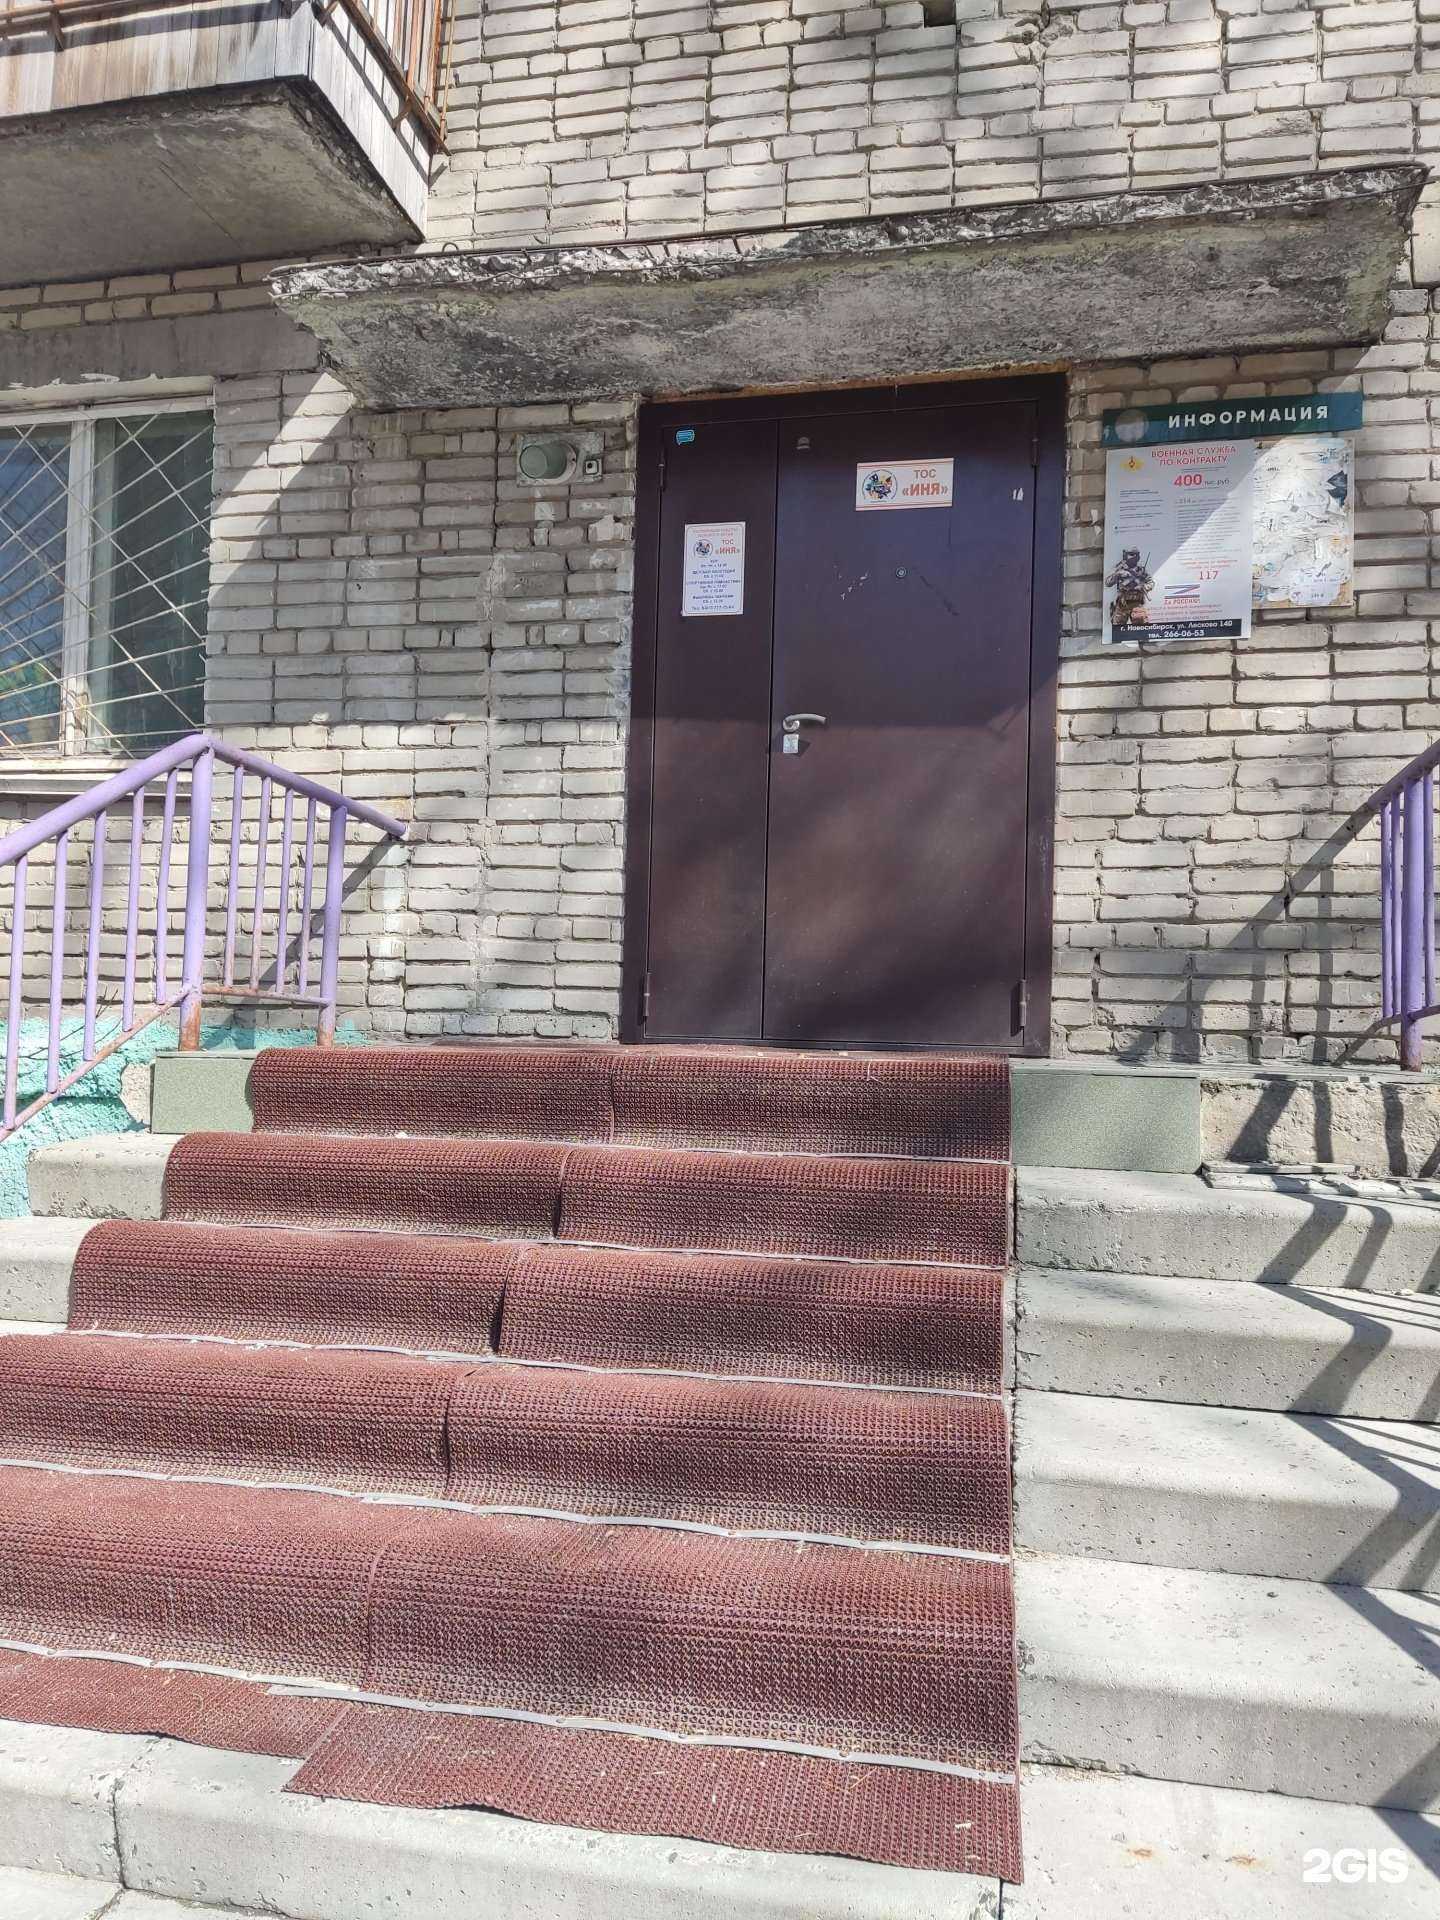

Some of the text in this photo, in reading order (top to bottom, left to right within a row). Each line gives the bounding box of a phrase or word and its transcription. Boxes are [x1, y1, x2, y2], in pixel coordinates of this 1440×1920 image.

[1168, 405, 1329, 429] ИНФОРМАЦИЯ
[1151, 445, 1236, 458] ВОЕННАЯ СЛУЖБА
[1177, 455, 1228, 465] КОНТРАКТУ
[913, 468, 937, 480] ТОС
[1174, 474, 1203, 488] 400
[902, 482, 949, 497] «ИНЯ»
[1199, 570, 1219, 581] 117
[1127, 622, 1176, 632] Новосибирск,
[1220, 619, 1233, 627] 140
[1164, 630, 1205, 639] 266-06-53
